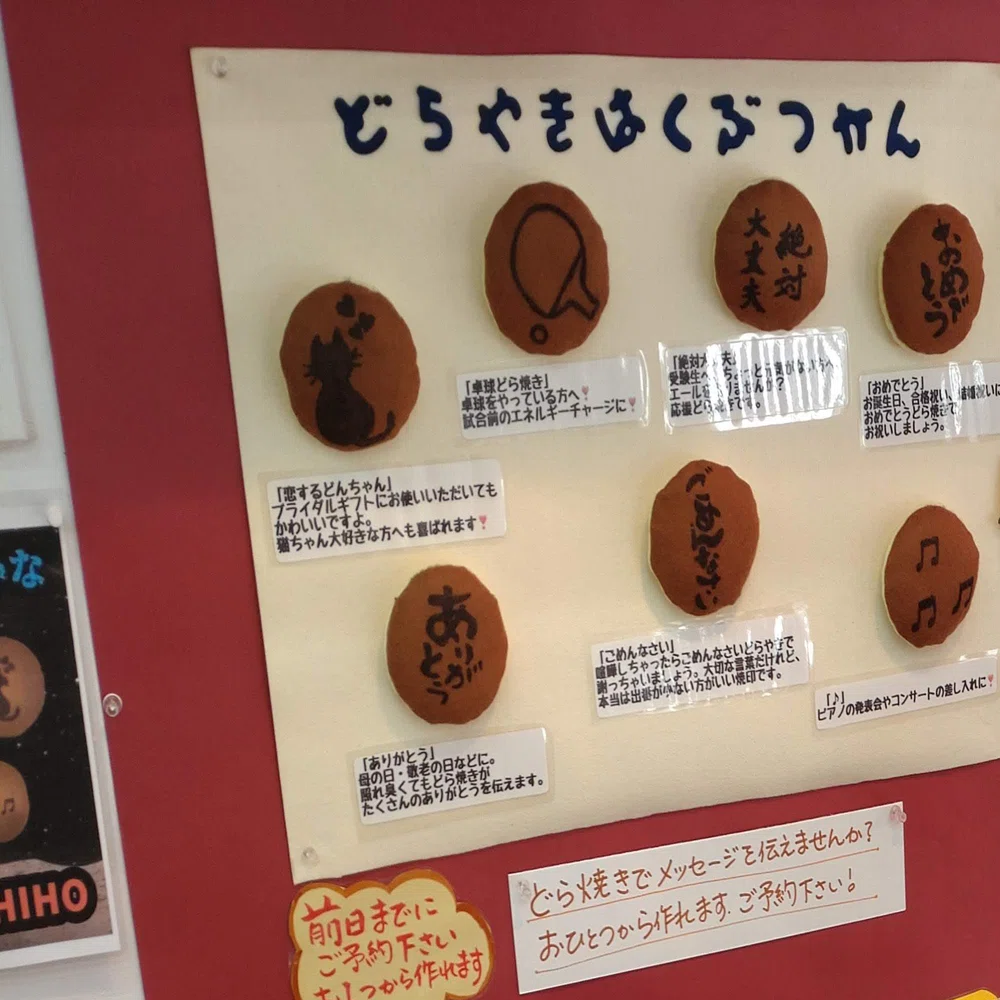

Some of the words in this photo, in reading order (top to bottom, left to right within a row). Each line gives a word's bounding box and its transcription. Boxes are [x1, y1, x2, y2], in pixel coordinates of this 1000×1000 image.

[334, 85, 921, 157] どらやきはくぶつかん
[465, 373, 549, 396] 「卓球どら焼き」
[867, 376, 925, 396] 「おめでとう」
[864, 418, 945, 440] お祝いしましょう。
[277, 475, 393, 502] 「恋するどんちゃん」
[274, 512, 372, 537] かわいいですよ。
[599, 638, 675, 665] 「ごめんなさい」
[362, 746, 435, 772] 「ありがとう」
[300, 895, 439, 948] 前日までに
[317, 928, 458, 979] ご予約下さい
